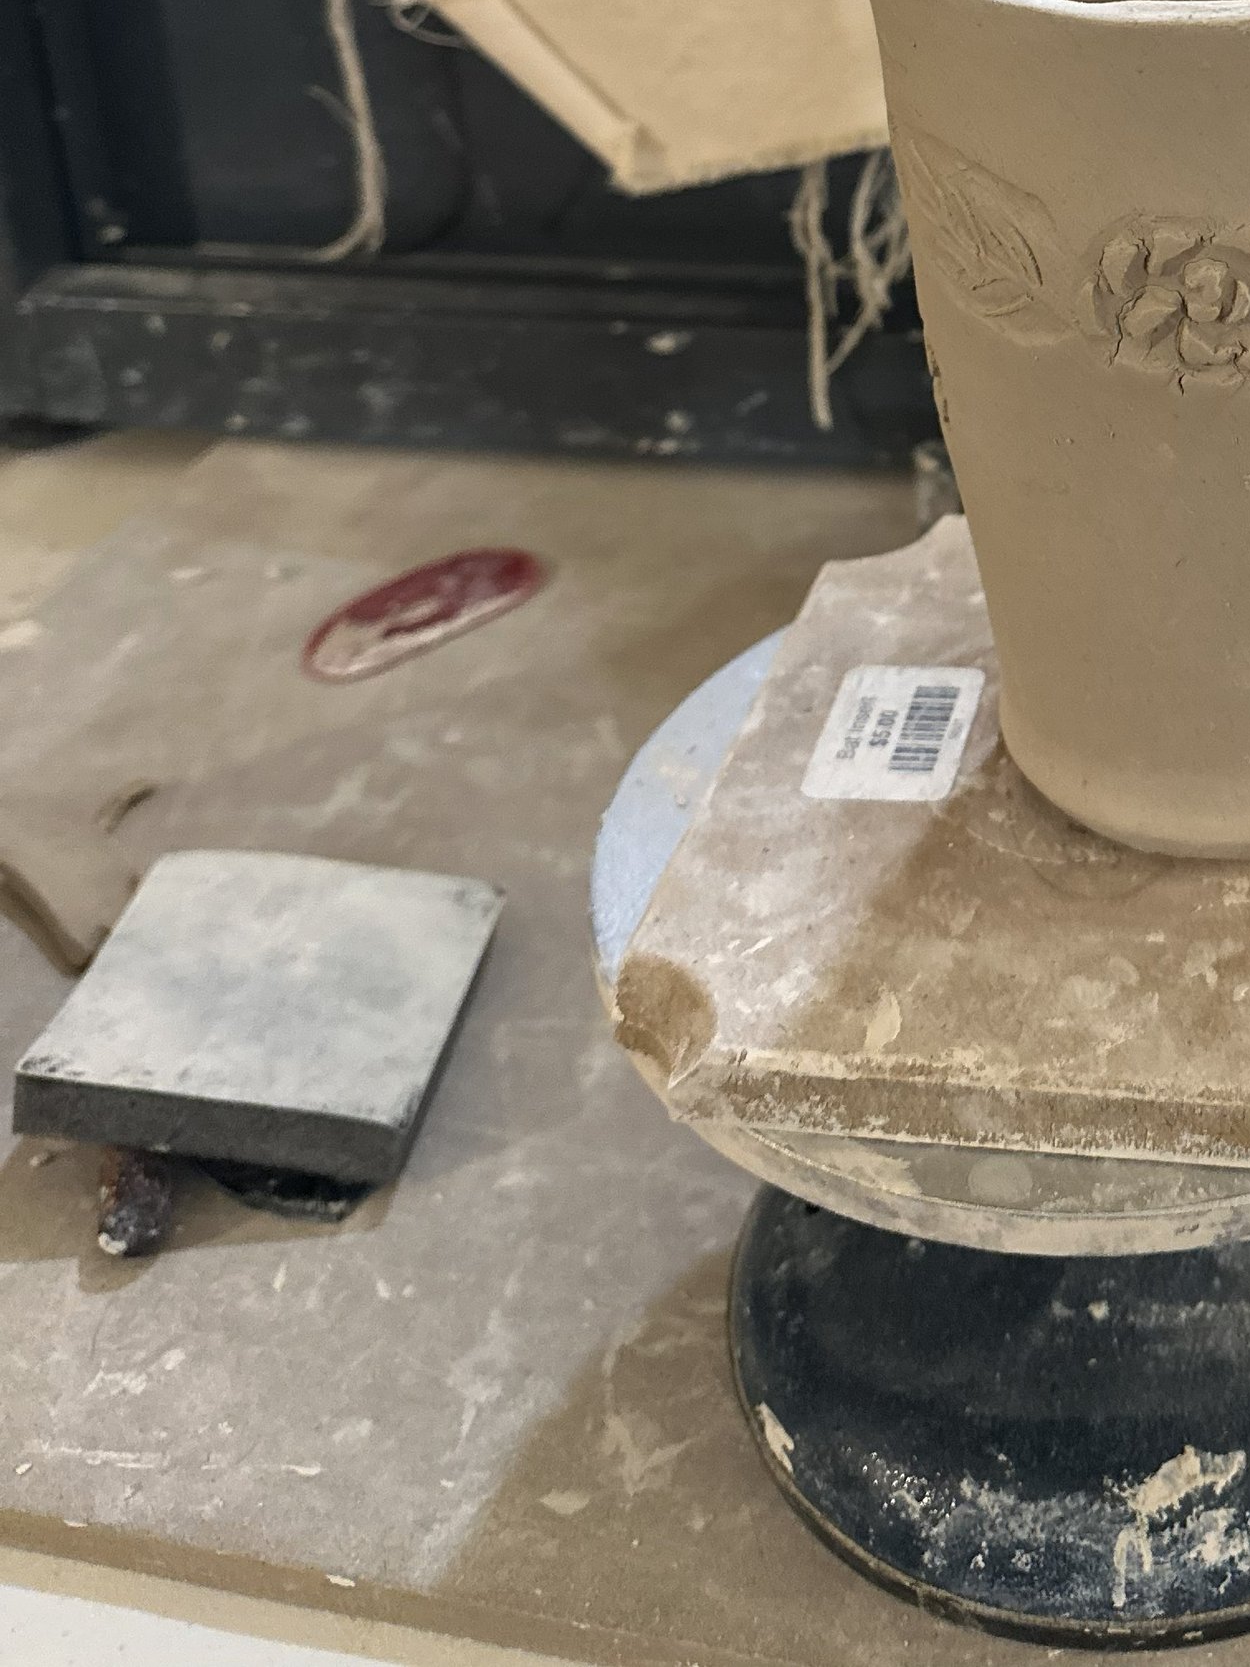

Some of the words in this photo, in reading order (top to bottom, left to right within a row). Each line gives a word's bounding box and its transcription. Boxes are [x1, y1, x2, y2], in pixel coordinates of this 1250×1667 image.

[848, 695, 878, 732] Insert
[868, 709, 899, 746] $5.00
[835, 736, 862, 760] Bat
